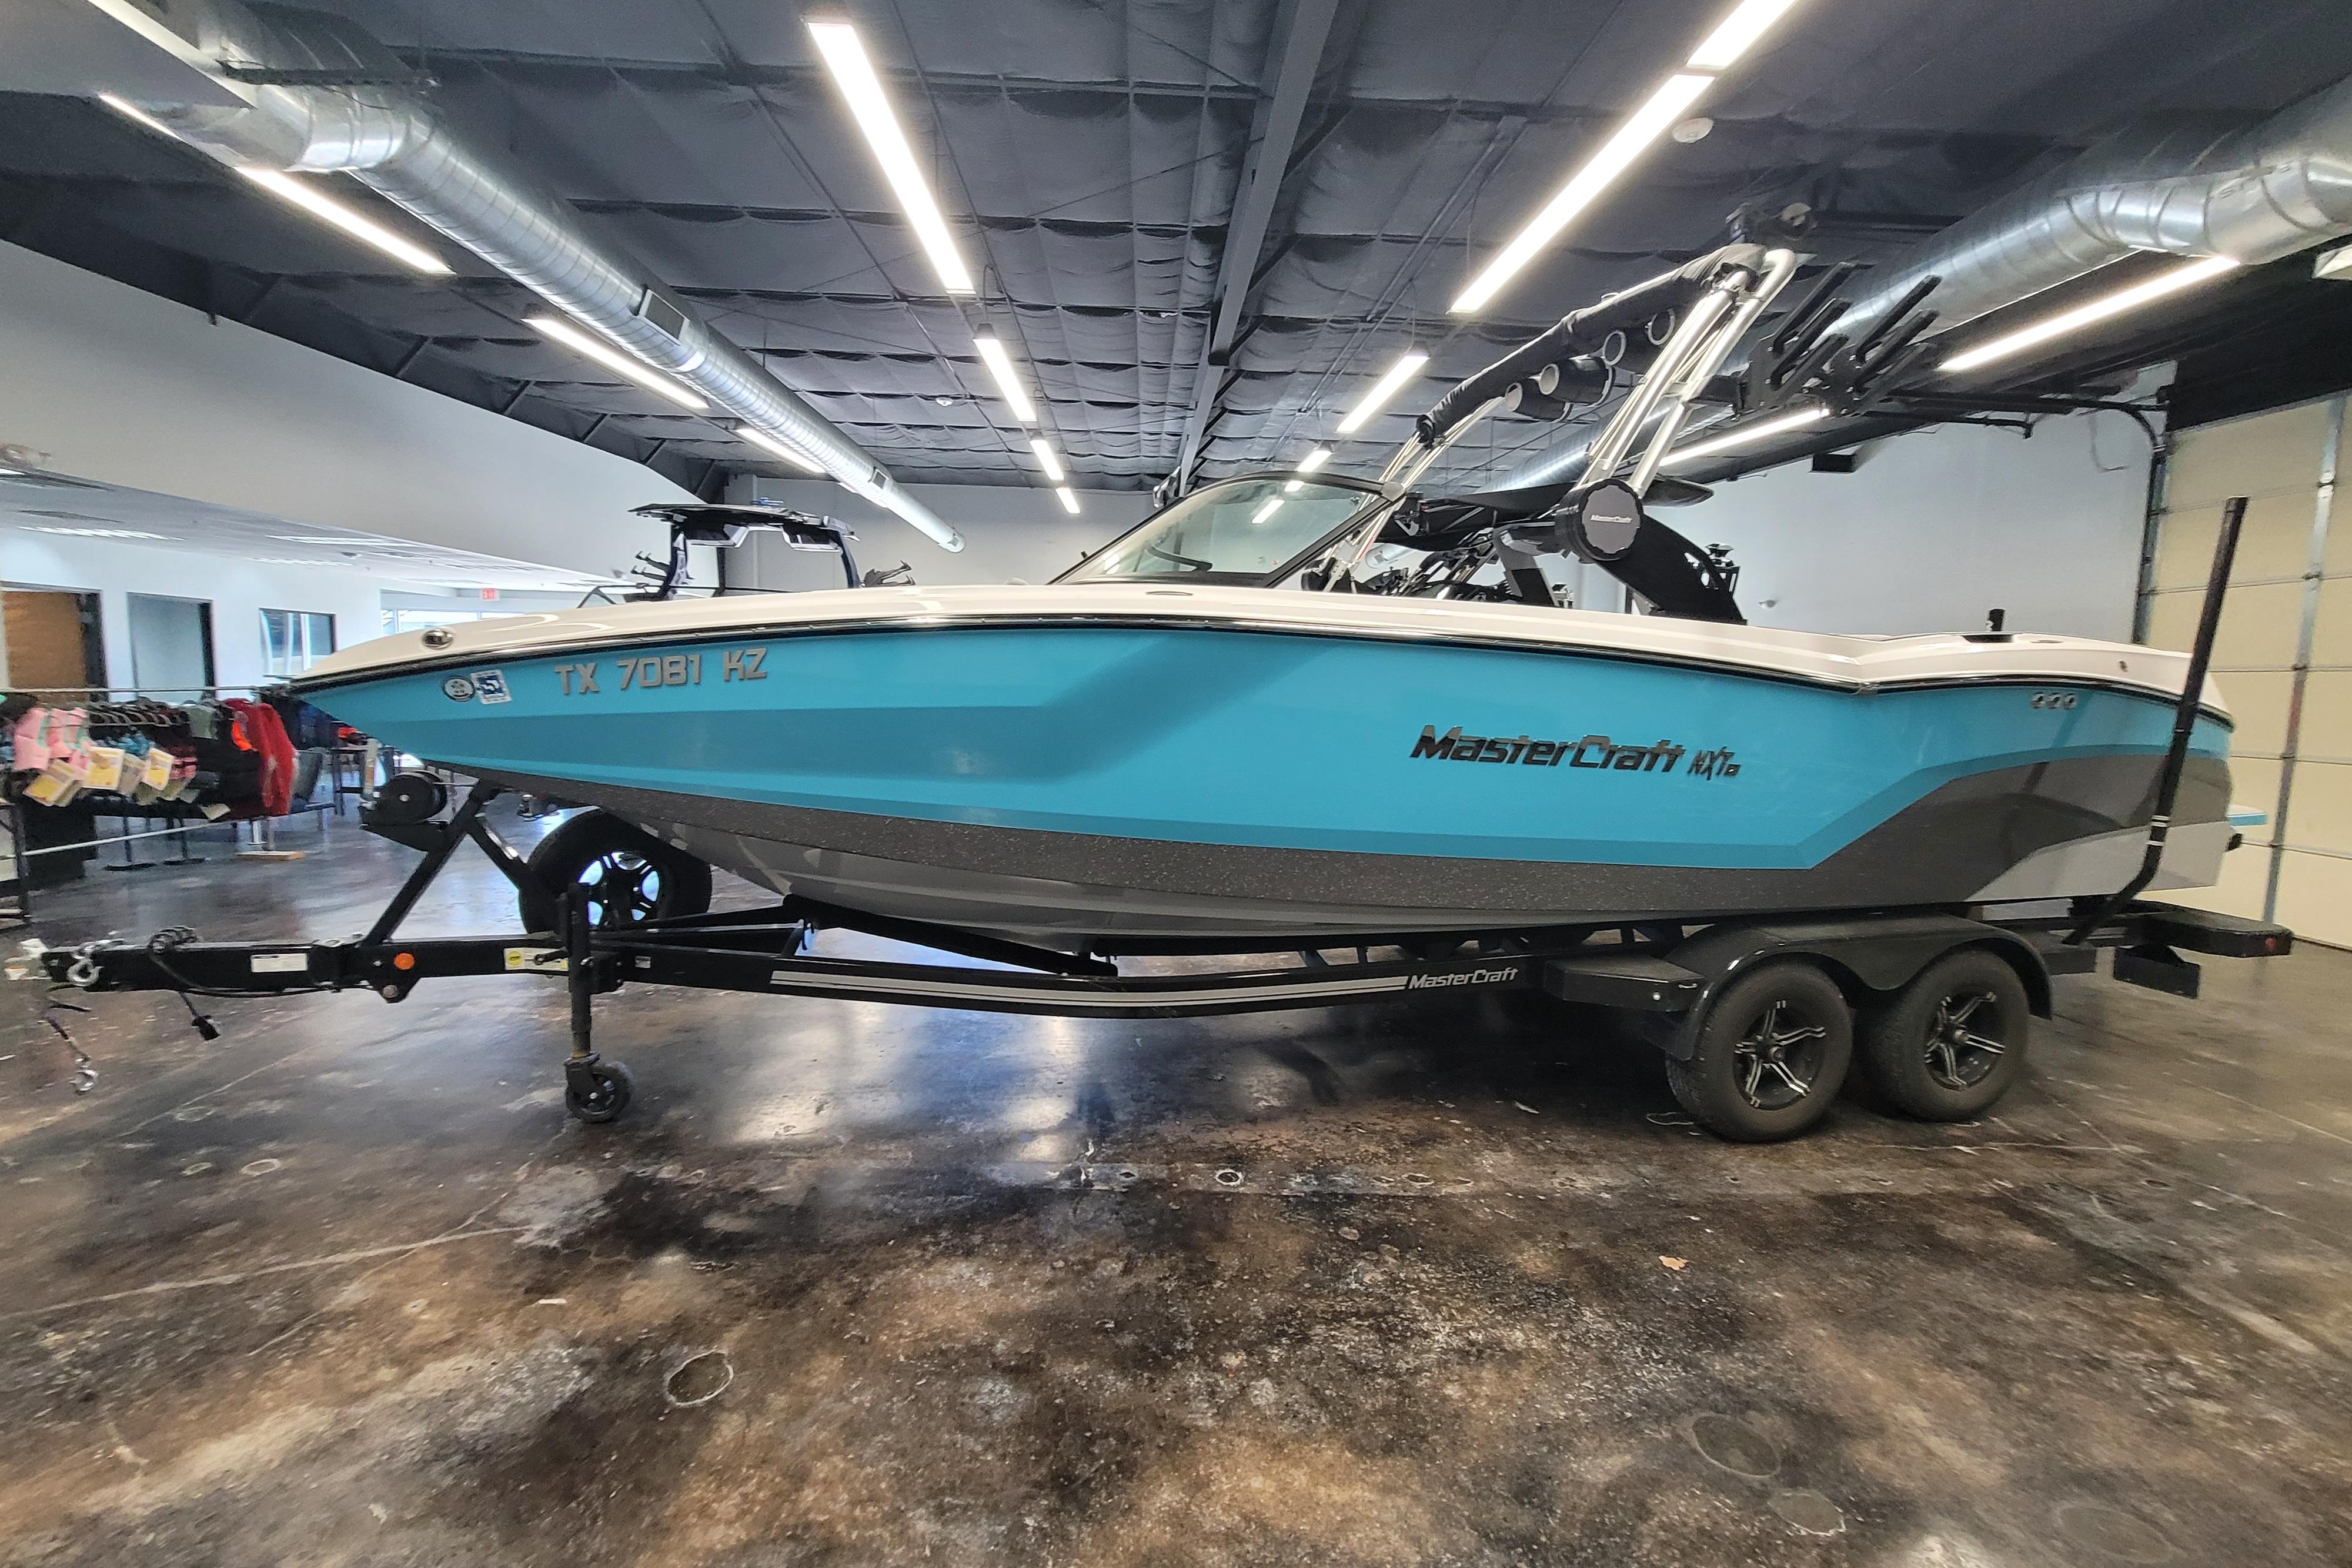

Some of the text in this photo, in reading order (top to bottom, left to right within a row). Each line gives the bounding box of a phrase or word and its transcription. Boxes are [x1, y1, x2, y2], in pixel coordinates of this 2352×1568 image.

[554, 647, 768, 695] TX 7081 KZ
[1409, 724, 1686, 773] MasterCraft
[1408, 967, 1518, 989] MasterCraft
